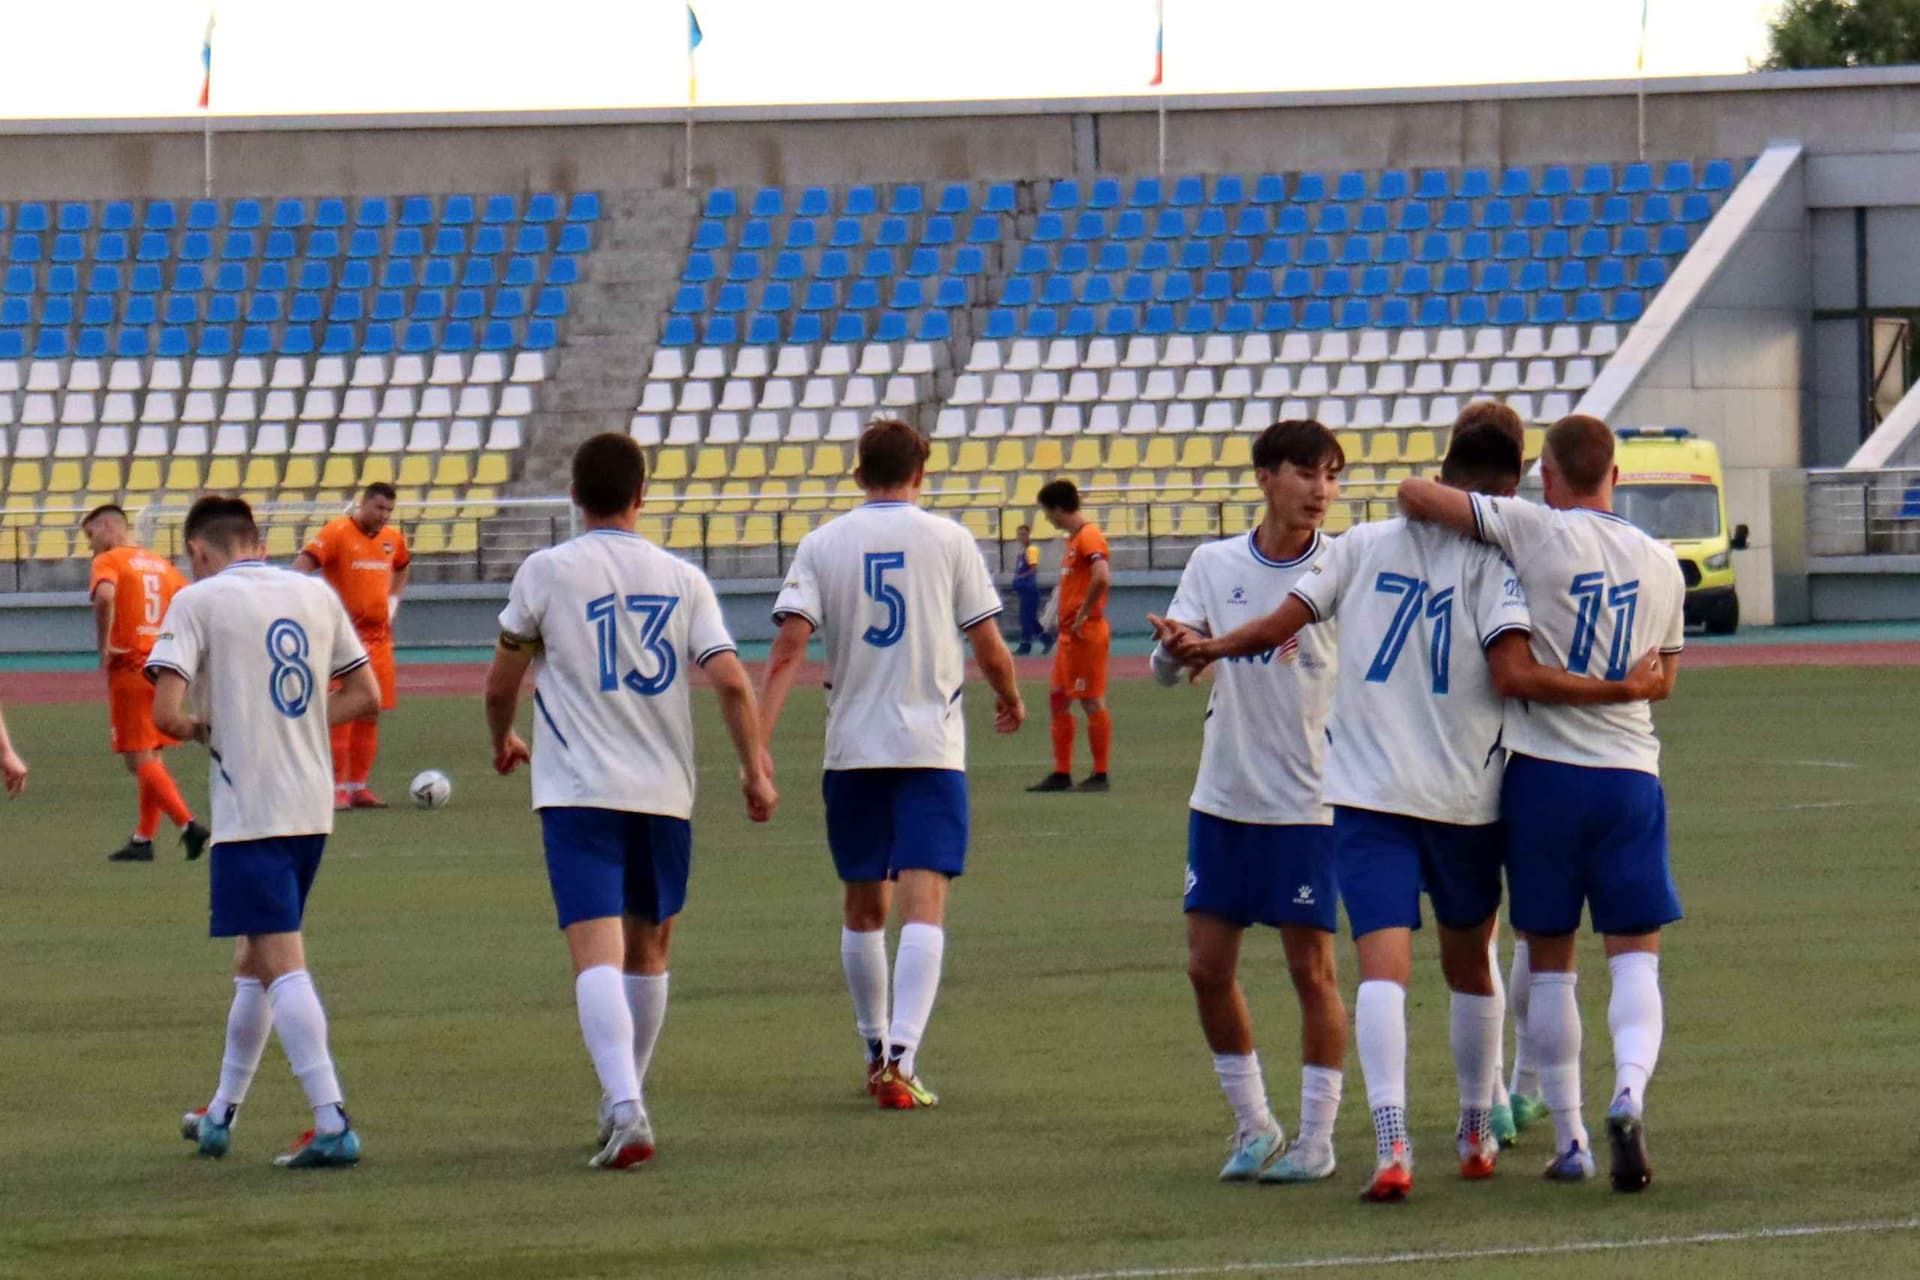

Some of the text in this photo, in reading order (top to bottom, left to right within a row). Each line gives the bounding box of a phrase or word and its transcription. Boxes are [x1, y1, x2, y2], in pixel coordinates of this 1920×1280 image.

[142, 574, 161, 624] 5
[586, 593, 680, 695] 13
[862, 551, 907, 648] 5
[1365, 571, 1455, 694] 71
[1567, 570, 1640, 681] 11
[266, 618, 313, 718] 8
